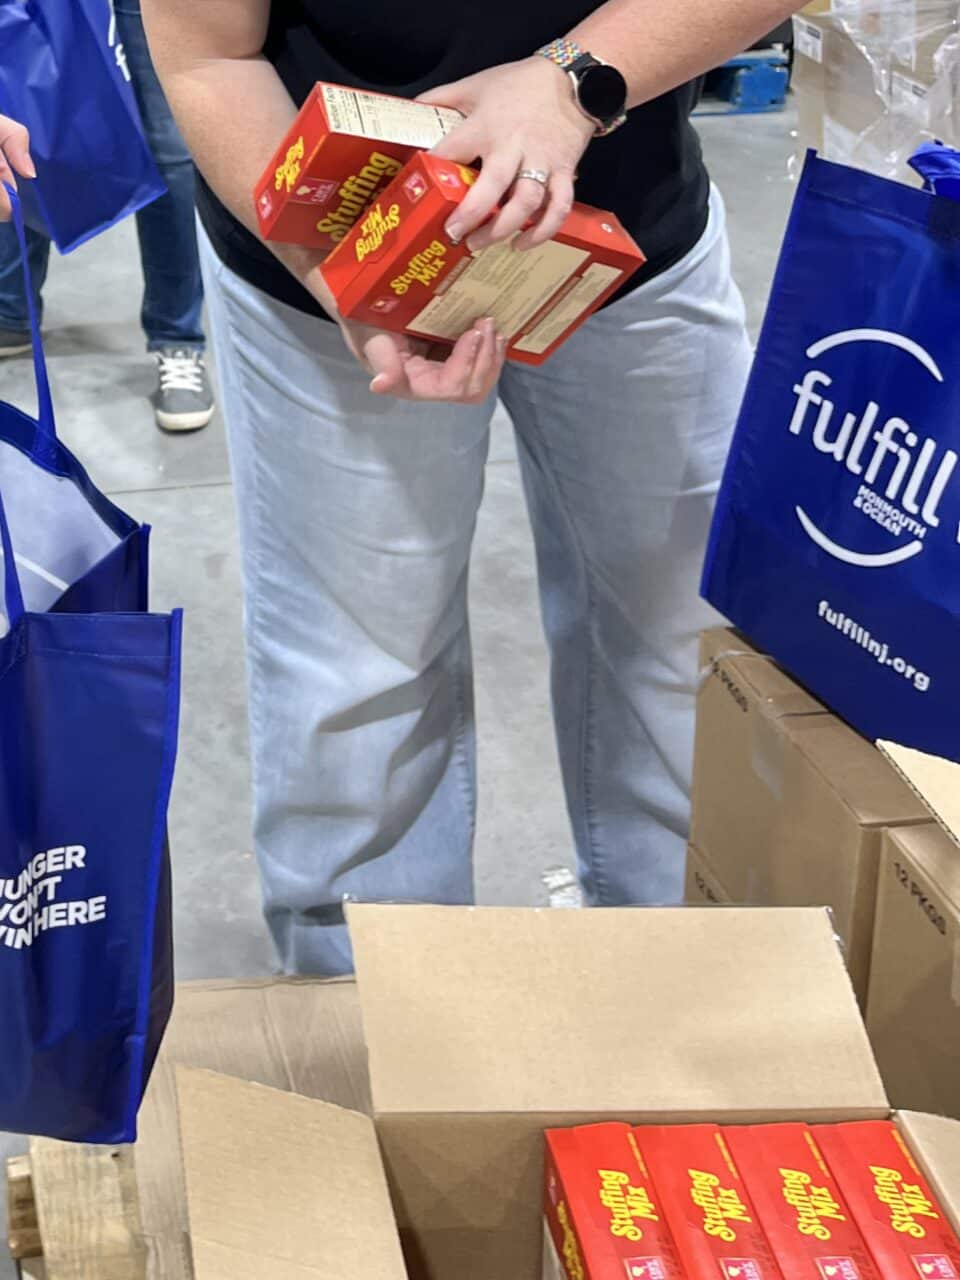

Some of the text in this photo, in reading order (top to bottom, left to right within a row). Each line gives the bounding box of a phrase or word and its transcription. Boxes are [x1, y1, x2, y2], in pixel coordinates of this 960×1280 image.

[316, 151, 403, 242] Stuffing
[360, 203, 383, 235] Mix
[355, 204, 400, 262] Stuffing
[390, 239, 447, 296] Stuffing
[415, 257, 446, 287] Mix
[789, 370, 958, 528] fulfill
[856, 485, 928, 539] MONMOUTH
[817, 599, 931, 692] fulfillnj.org
[33, 895, 107, 937] HERE
[598, 1169, 643, 1241] Stuffing
[627, 1184, 659, 1222] Mix
[688, 1168, 737, 1242] Stuffing
[718, 1186, 753, 1223] Mix
[778, 1167, 832, 1240] Stuffing
[809, 1183, 846, 1222] Mix
[868, 1166, 926, 1239] Stuffing
[900, 1182, 939, 1219] Mix
